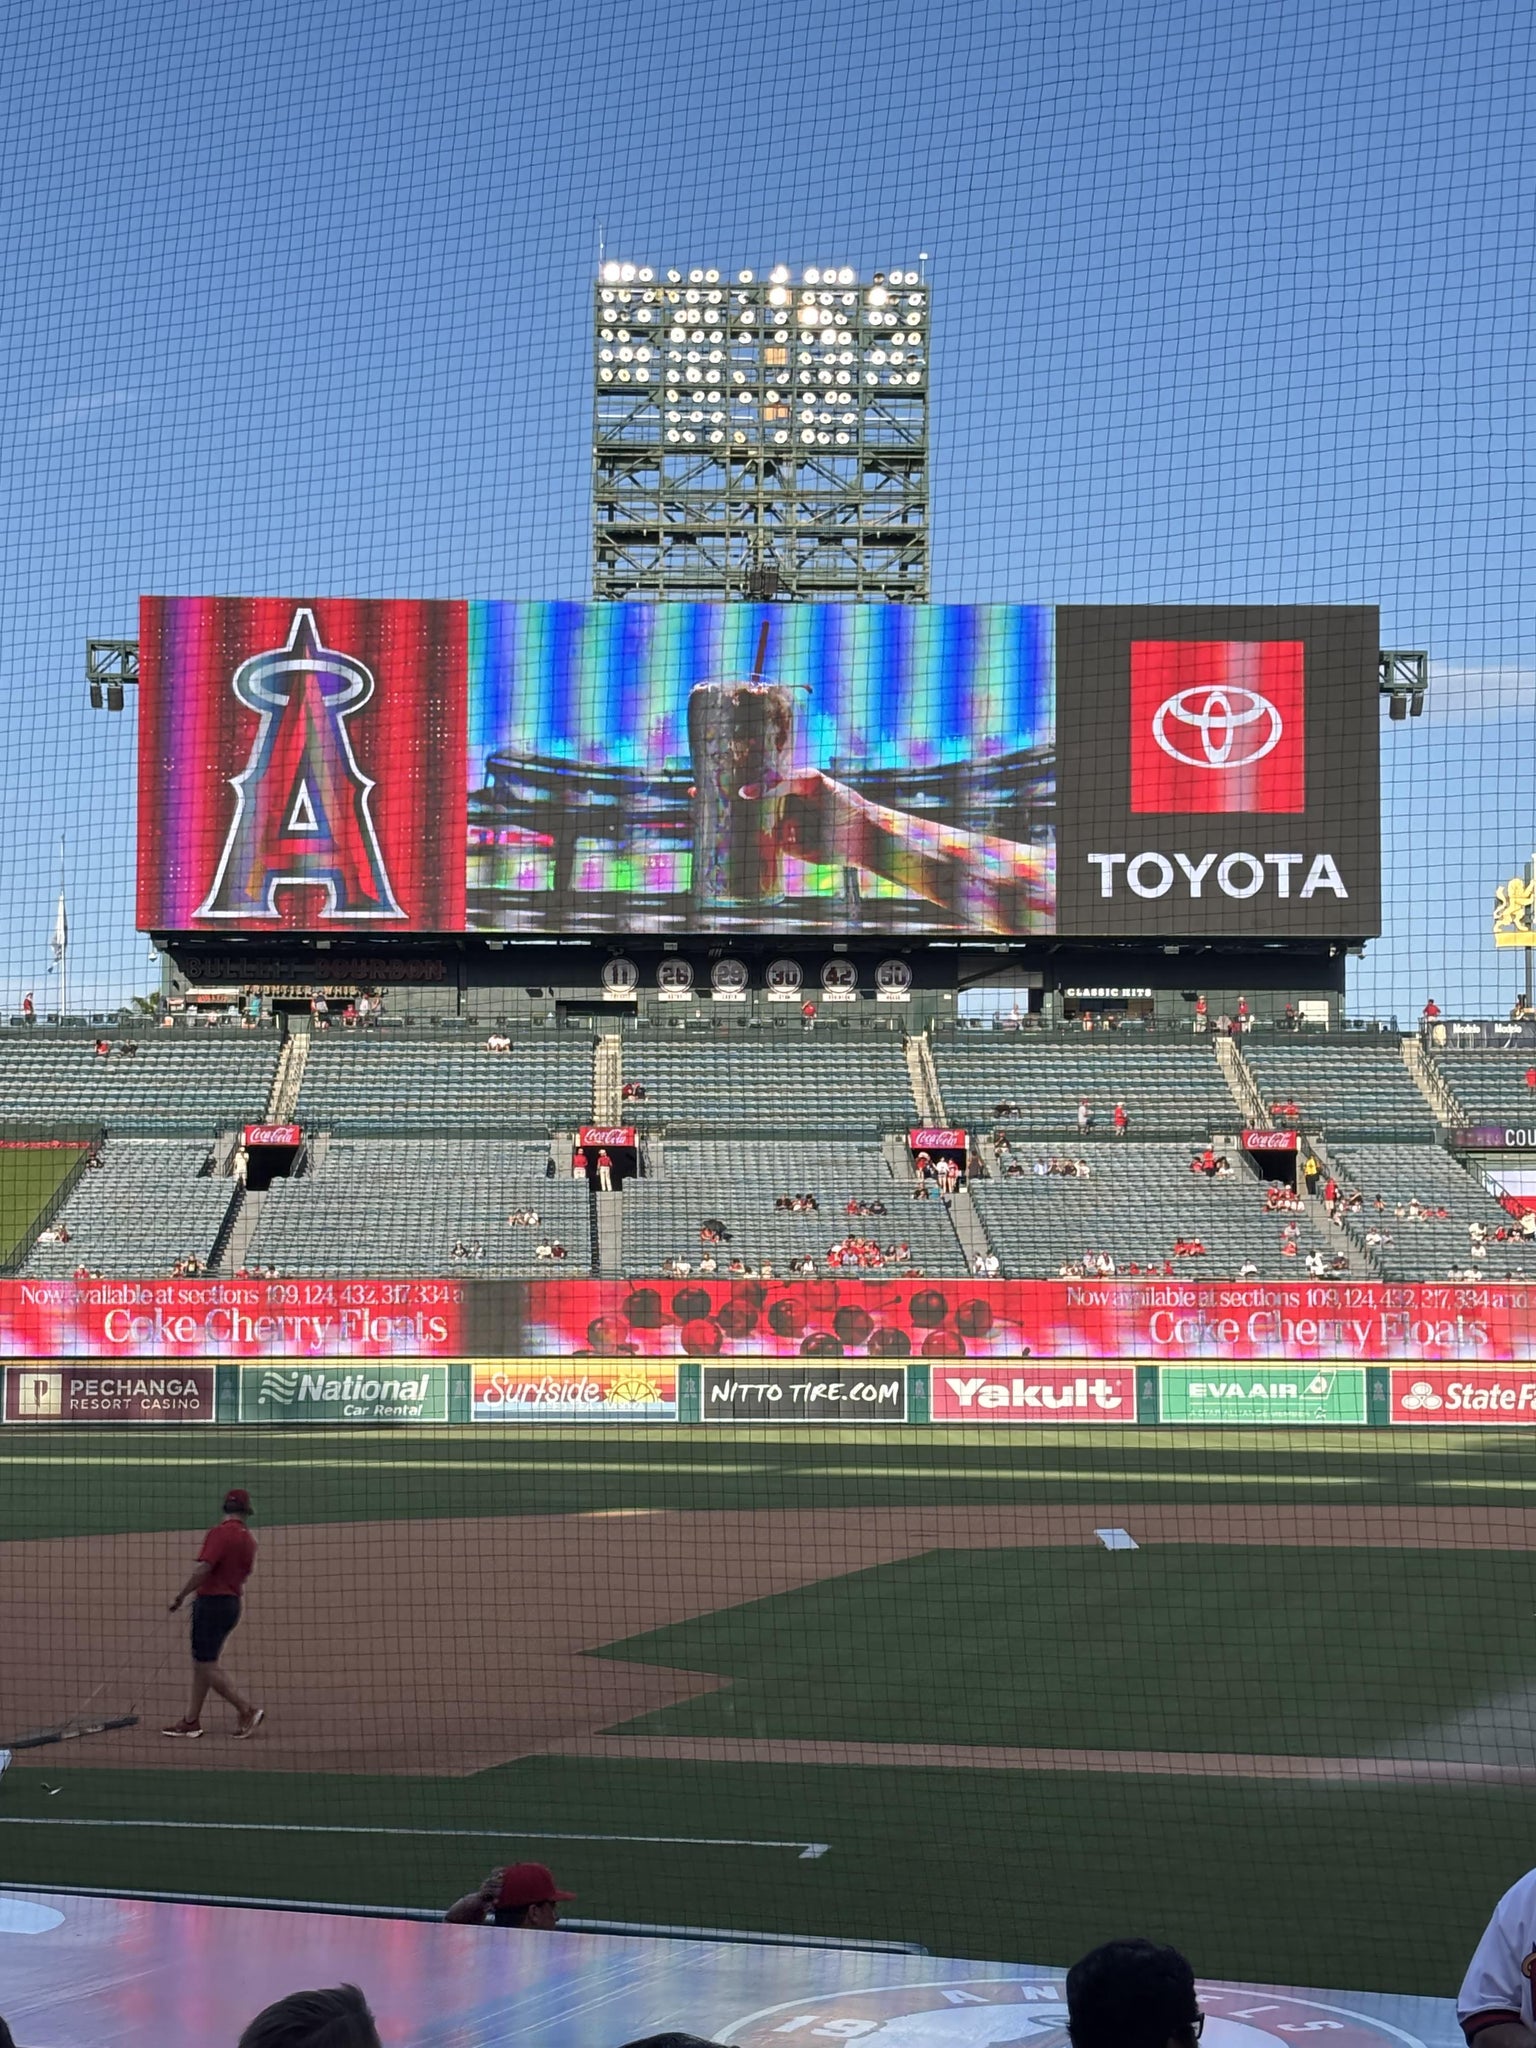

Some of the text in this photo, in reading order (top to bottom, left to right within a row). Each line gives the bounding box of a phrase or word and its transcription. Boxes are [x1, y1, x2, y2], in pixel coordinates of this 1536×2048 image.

[1088, 852, 1348, 898] TOYOTA
[315, 959, 444, 980] BOURBON
[612, 964, 628, 985] 11
[663, 967, 688, 985] 26
[717, 965, 742, 985] 29
[772, 967, 797, 985] 30
[825, 966, 851, 985] 42
[1067, 988, 1151, 997] CLASSIC HITS
[20, 1285, 63, 1305] Now
[71, 1284, 152, 1305] available
[155, 1285, 174, 1305] at
[178, 1284, 258, 1305] sections
[305, 1285, 338, 1307] 124,
[1067, 1287, 1109, 1306] Now
[1113, 1287, 1195, 1307] available
[1196, 1288, 1215, 1307] at
[1220, 1288, 1300, 1308] sections
[1306, 1289, 1341, 1309] 109,
[1345, 1289, 1377, 1310] 124,
[1380, 1289, 1418, 1309] 432,
[104, 1308, 448, 1350] Coke Cherry Floats
[1150, 1310, 1488, 1351] Coke Cherry Floats
[70, 1379, 199, 1396] PECHANGA
[298, 1373, 430, 1401] National
[483, 1372, 600, 1408] Surfside
[711, 1379, 782, 1402] NITTO
[789, 1381, 899, 1405] TIRE.COM
[945, 1378, 1122, 1409] Yakult
[70, 1398, 200, 1410] RESORT CASINO
[343, 1404, 423, 1417] Car Rental
